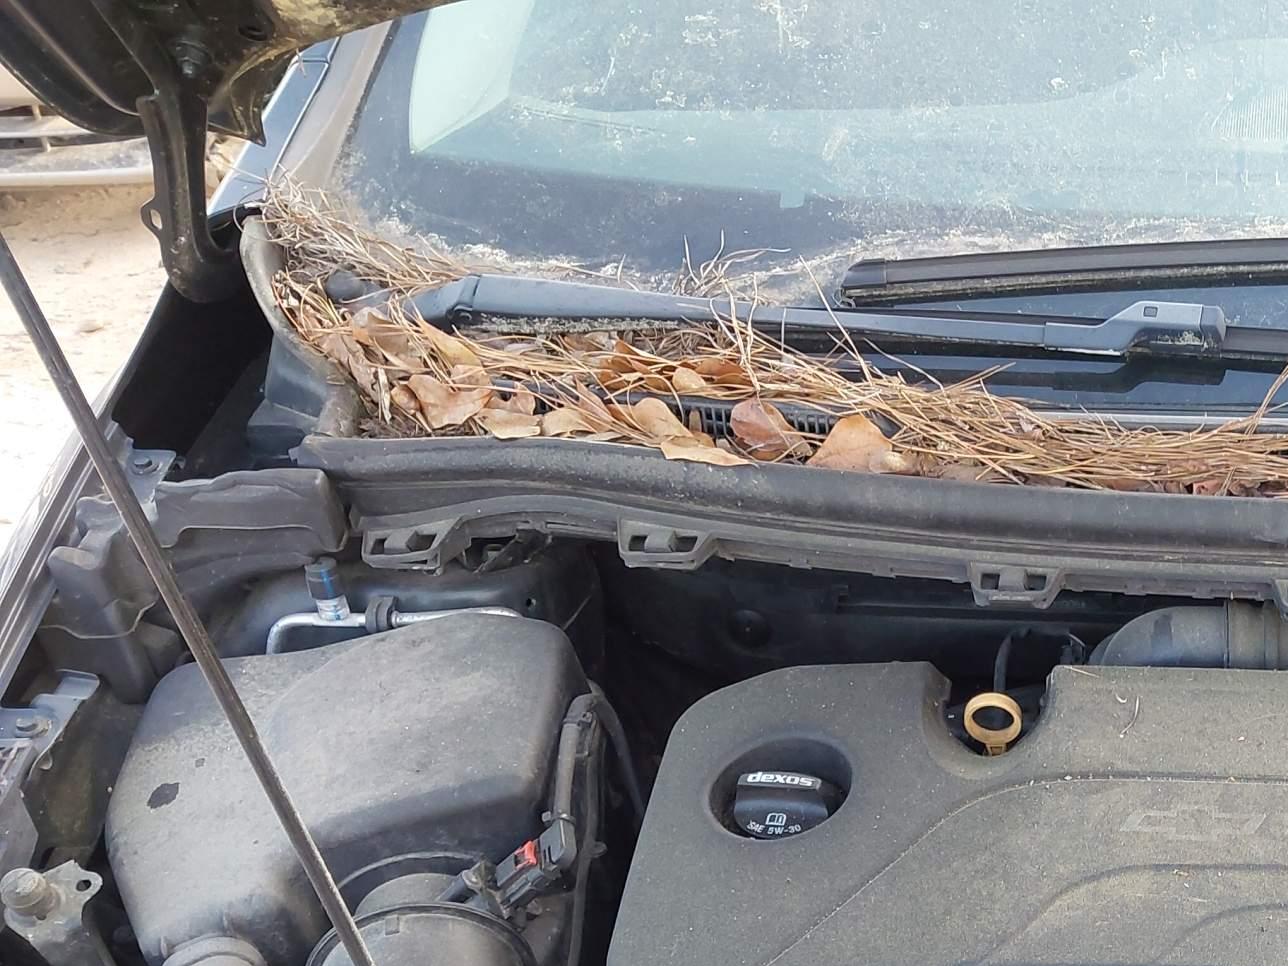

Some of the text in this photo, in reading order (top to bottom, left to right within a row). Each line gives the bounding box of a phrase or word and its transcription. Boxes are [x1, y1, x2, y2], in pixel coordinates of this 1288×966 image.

[747, 772, 814, 786] dexos
[747, 822, 801, 835] SAE 5W-30
